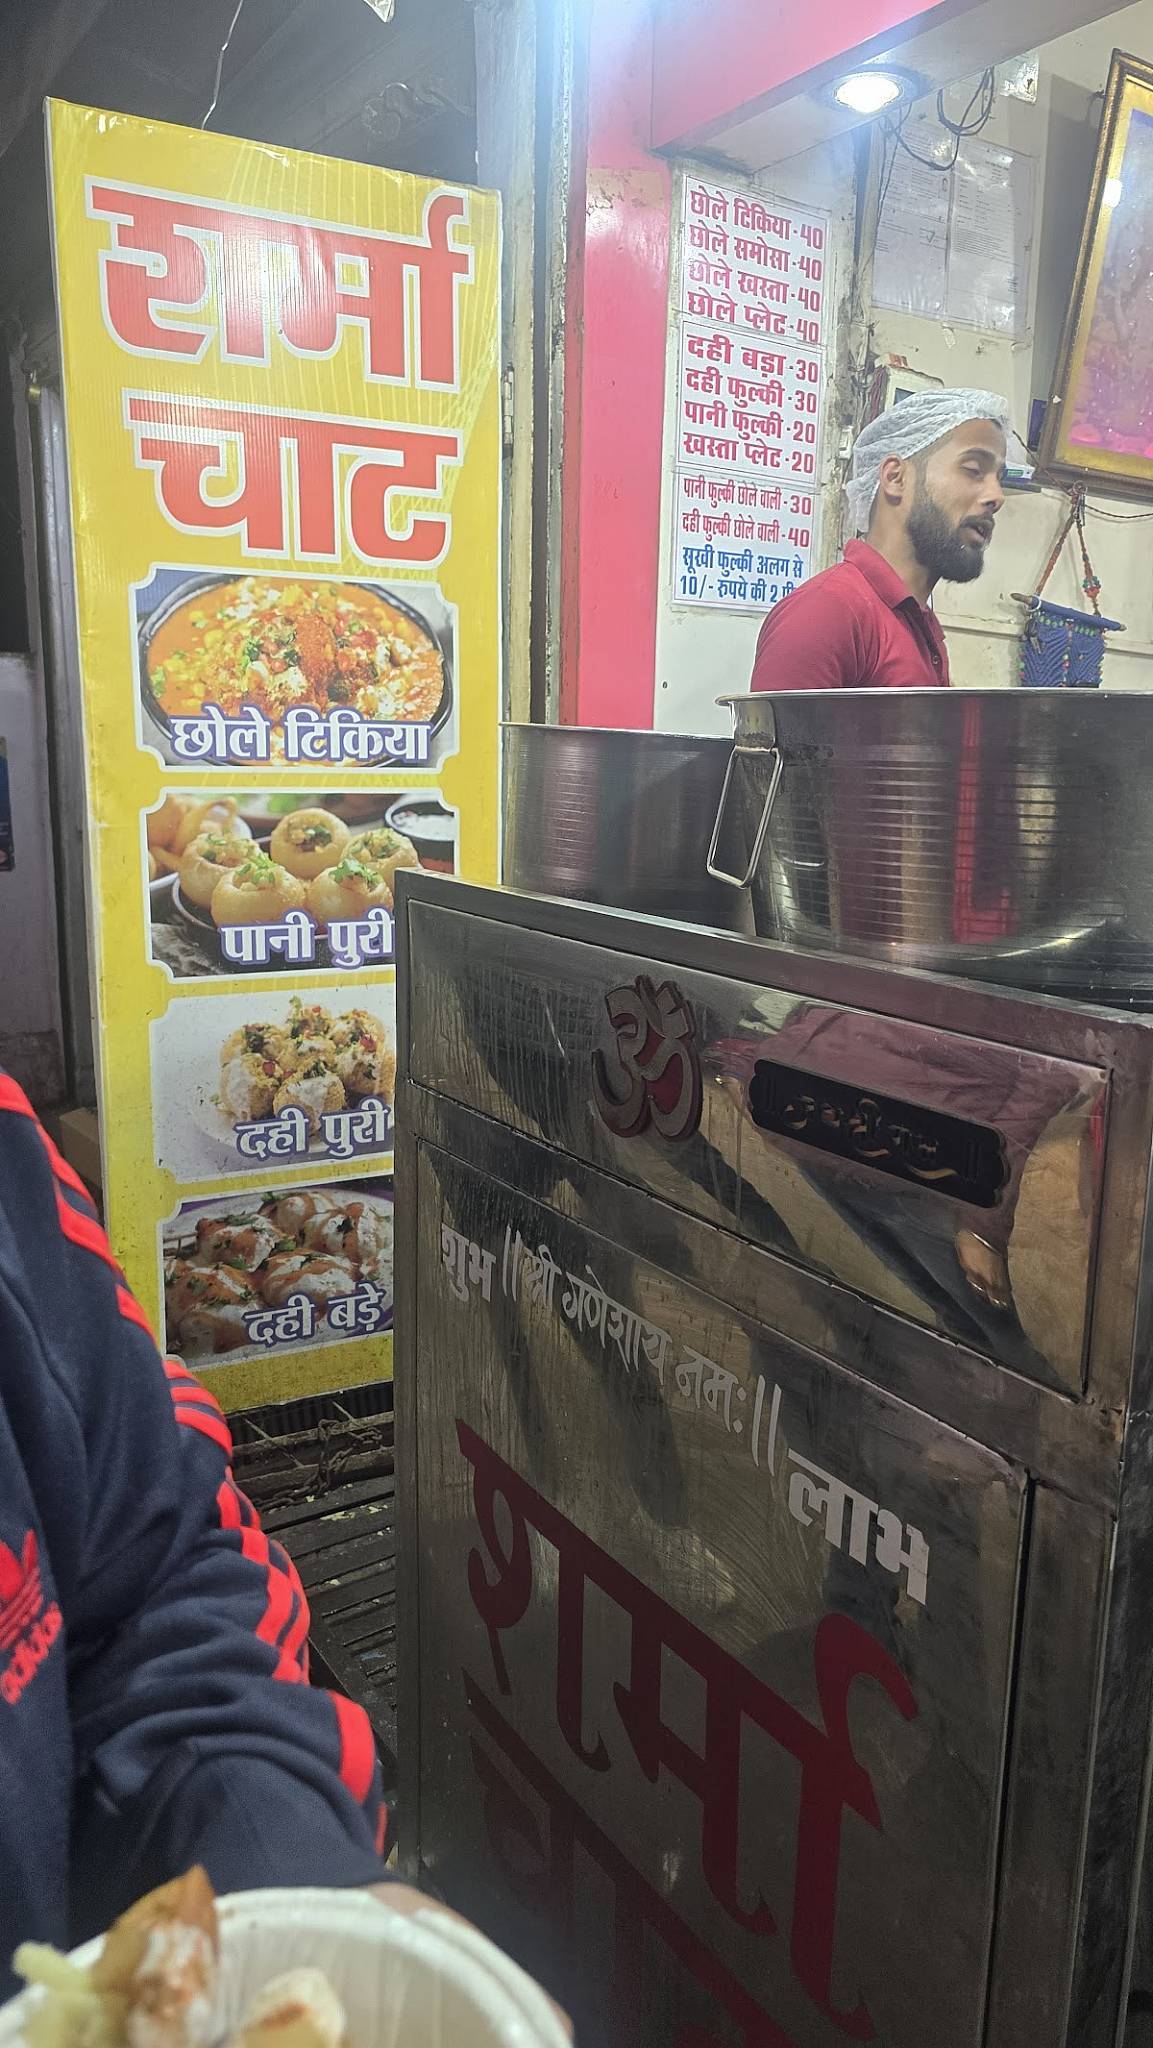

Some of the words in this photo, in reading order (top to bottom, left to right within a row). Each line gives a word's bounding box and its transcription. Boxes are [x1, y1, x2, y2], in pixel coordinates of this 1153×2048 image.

[690, 185, 728, 222] छोले
[733, 198, 792, 240] टिकिया
[689, 219, 729, 255] छोले
[734, 236, 790, 272] समोसा
[84, 176, 476, 393] शर्मा
[689, 253, 732, 289] छोले
[738, 271, 789, 304] खस्ता
[687, 287, 738, 322] छोले
[744, 302, 787, 334] प्लेट
[686, 334, 734, 364] दही
[741, 347, 786, 377] बड़ा
[685, 366, 723, 395] दही
[727, 379, 785, 408] फुल्की
[684, 400, 728, 428] पानी
[732, 411, 784, 440] फुल्की
[683, 432, 739, 461] खस्ता
[744, 438, 782, 468] प्लेट
[122, 389, 463, 569] चाट
[684, 475, 706, 499] पानी
[708, 479, 735, 508] फुल्की
[760, 486, 782, 510] वाली
[682, 508, 701, 532] दही
[703, 512, 731, 541] फुल्की
[734, 514, 755, 540] छोले
[757, 519, 780, 543] वाली
[682, 544, 714, 574] सूखी
[717, 549, 753, 576] फुल्की
[756, 555, 790, 577] अलग
[792, 554, 804, 578] से
[717, 575, 748, 600] रुपये
[750, 578, 767, 602] की
[770, 584, 778, 603] 2
[170, 704, 271, 759] छोले
[283, 708, 432, 761] टिकिया
[220, 911, 315, 963] पानी
[327, 906, 395, 966] पुरी
[236, 1106, 309, 1160] दही
[320, 1097, 389, 1157] पुरी
[245, 1293, 316, 1345] दही
[327, 1281, 385, 1331] बड़े
[440, 1224, 497, 1302] शुभ
[561, 1265, 672, 1386] गणेशाय
[788, 1448, 930, 1606] लाभ
[1, 1600, 63, 1705] adidas
[454, 1417, 919, 2040] शर्मा
